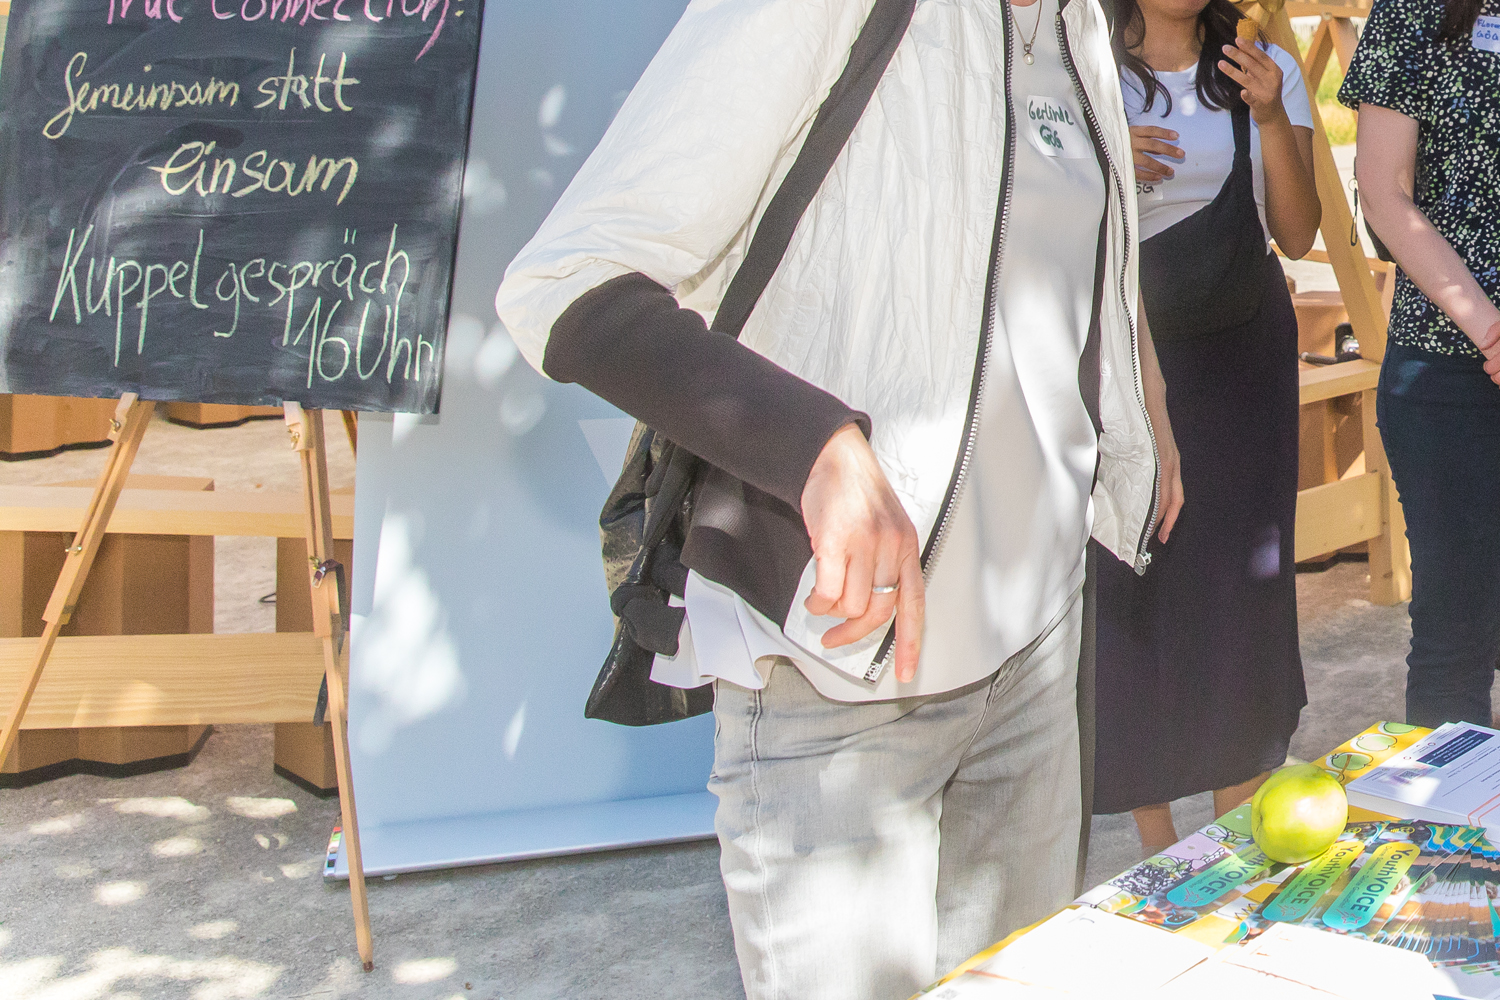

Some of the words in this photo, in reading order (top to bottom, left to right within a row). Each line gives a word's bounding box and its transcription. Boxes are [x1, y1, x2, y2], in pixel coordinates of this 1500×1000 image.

[43, 52, 239, 139] Gemeinsam
[254, 47, 360, 112] statt
[50, 223, 410, 368] Kuppelgespräch
[357, 299, 434, 384] Uhr
[1291, 845, 1358, 905] YouthVOICE
[1351, 848, 1413, 912] YouthVOICE
